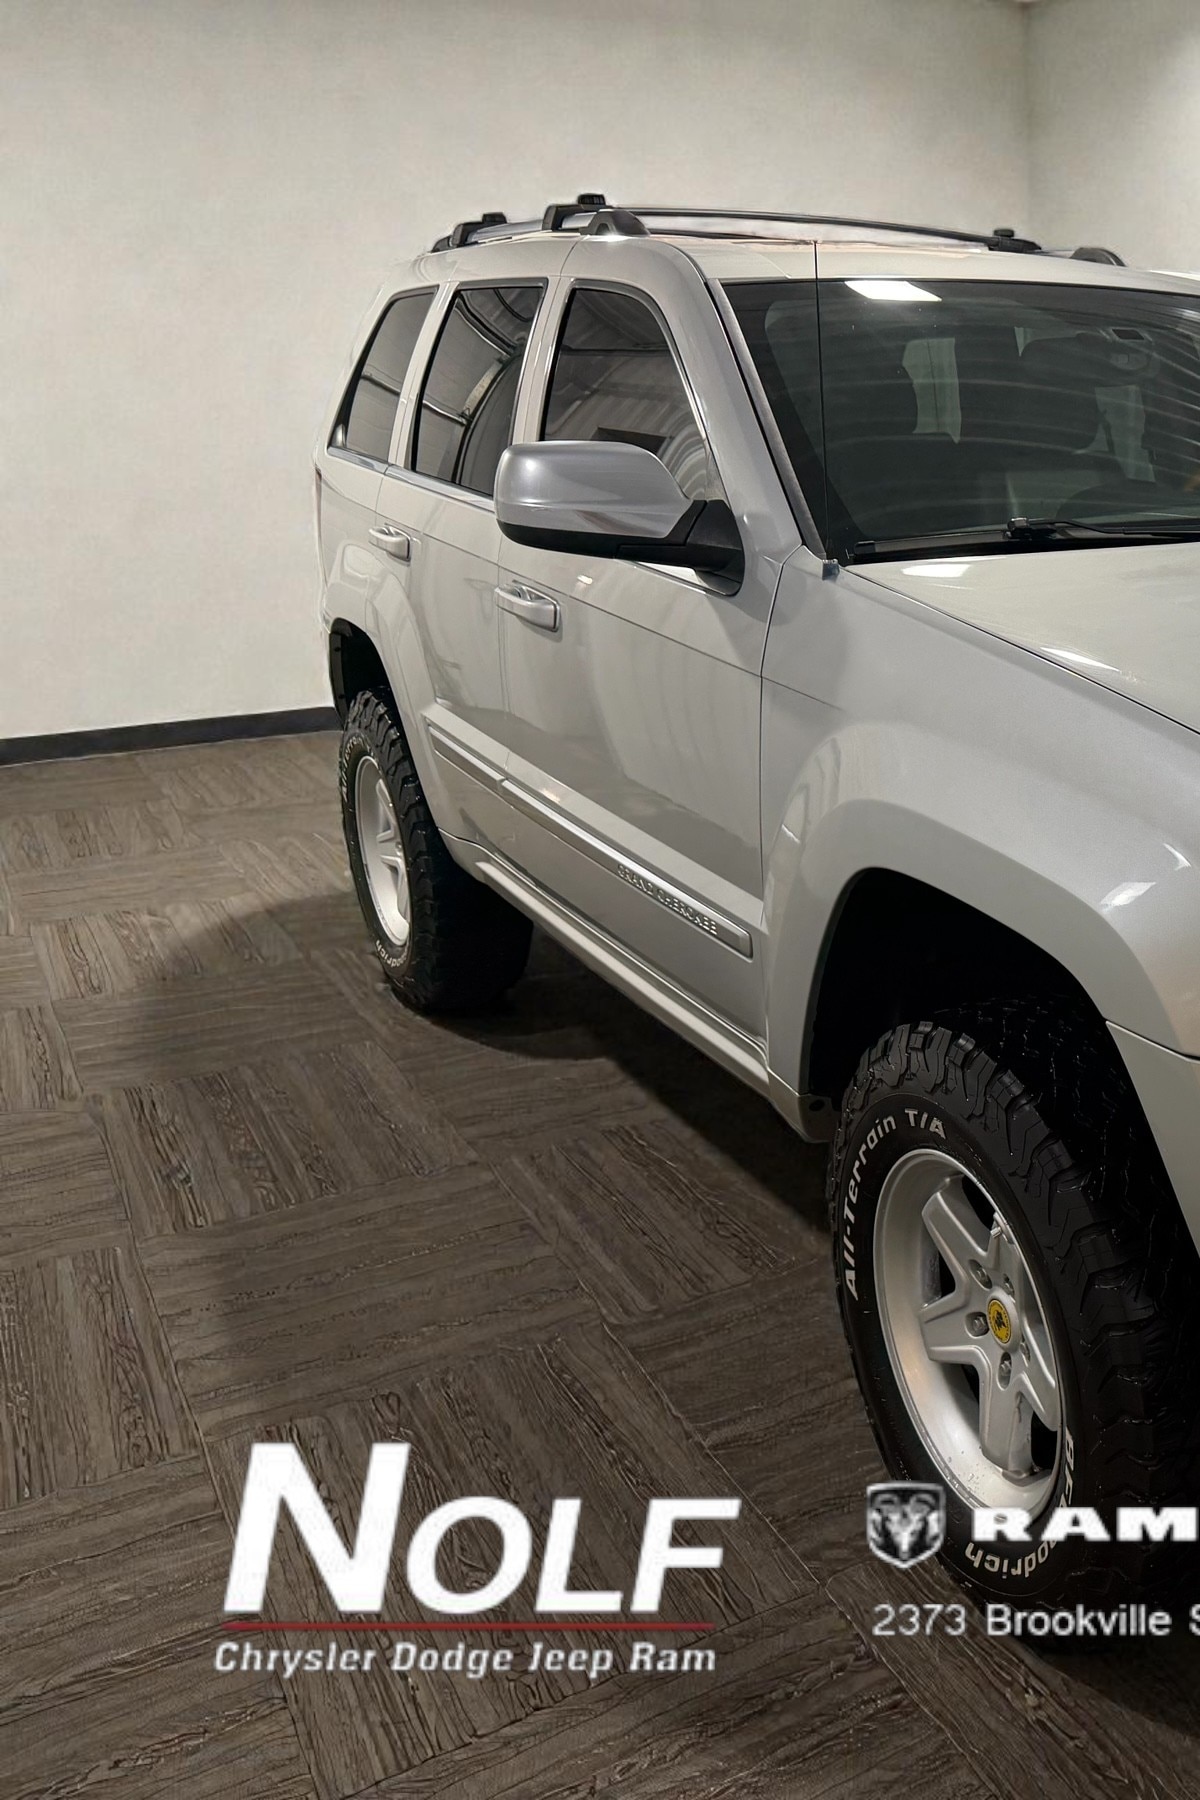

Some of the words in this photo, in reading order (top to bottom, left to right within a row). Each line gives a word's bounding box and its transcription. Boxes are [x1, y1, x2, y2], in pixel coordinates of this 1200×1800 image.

[617, 863, 654, 896] GRAND
[656, 887, 719, 936] CHEROKEE
[843, 1113, 897, 1300] All-Terrain
[904, 1107, 948, 1141] T/A
